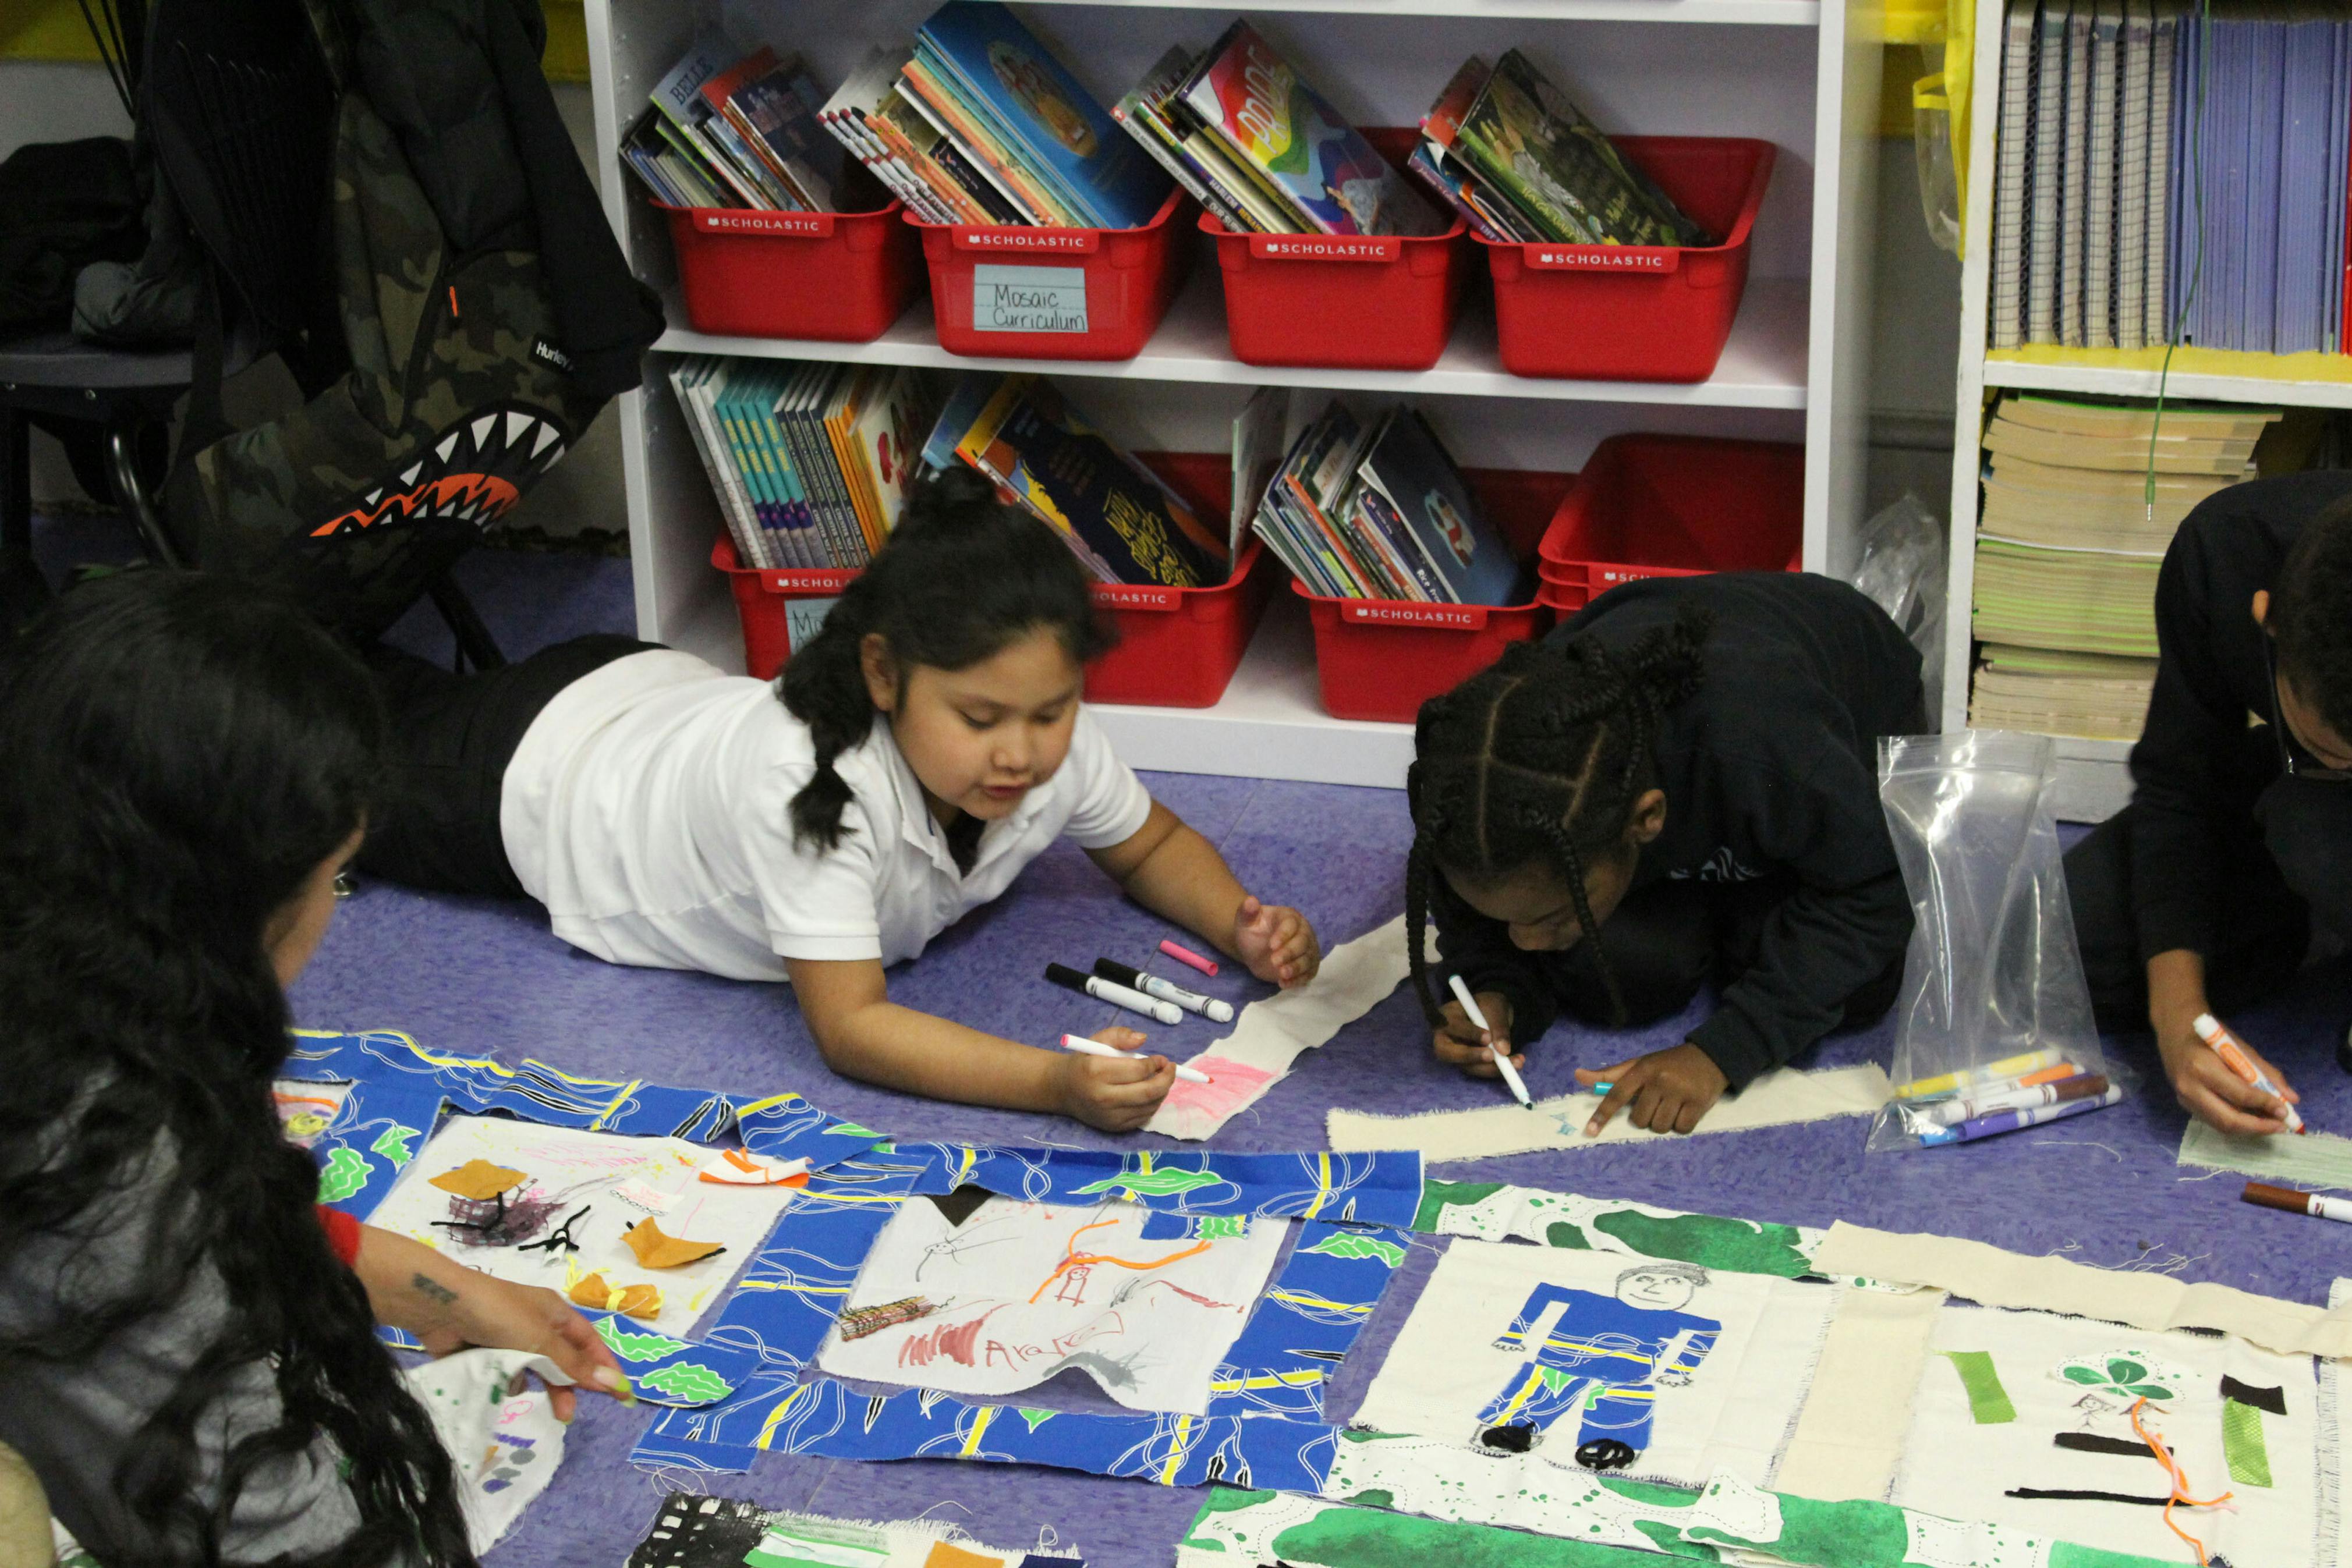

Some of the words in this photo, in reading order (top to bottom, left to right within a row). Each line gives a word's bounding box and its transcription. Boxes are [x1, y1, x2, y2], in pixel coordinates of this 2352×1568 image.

[1124, 120, 1140, 136] PETER
[1209, 201, 1225, 218] OUR
[1208, 179, 1238, 208] HARLEM
[722, 218, 819, 230] SCHOLASTIC
[983, 235, 1084, 247] SCHOLASTIC
[1281, 244, 1384, 256] SCHOLASTIC
[1556, 255, 1662, 266] SCHOLASTIC
[994, 284, 1059, 308] Mosaic
[993, 307, 1085, 331] Curriculum
[536, 341, 571, 368] Hurley
[1417, 569, 1430, 587] Rice
[1370, 609, 1471, 623] SCHOLASTIC
